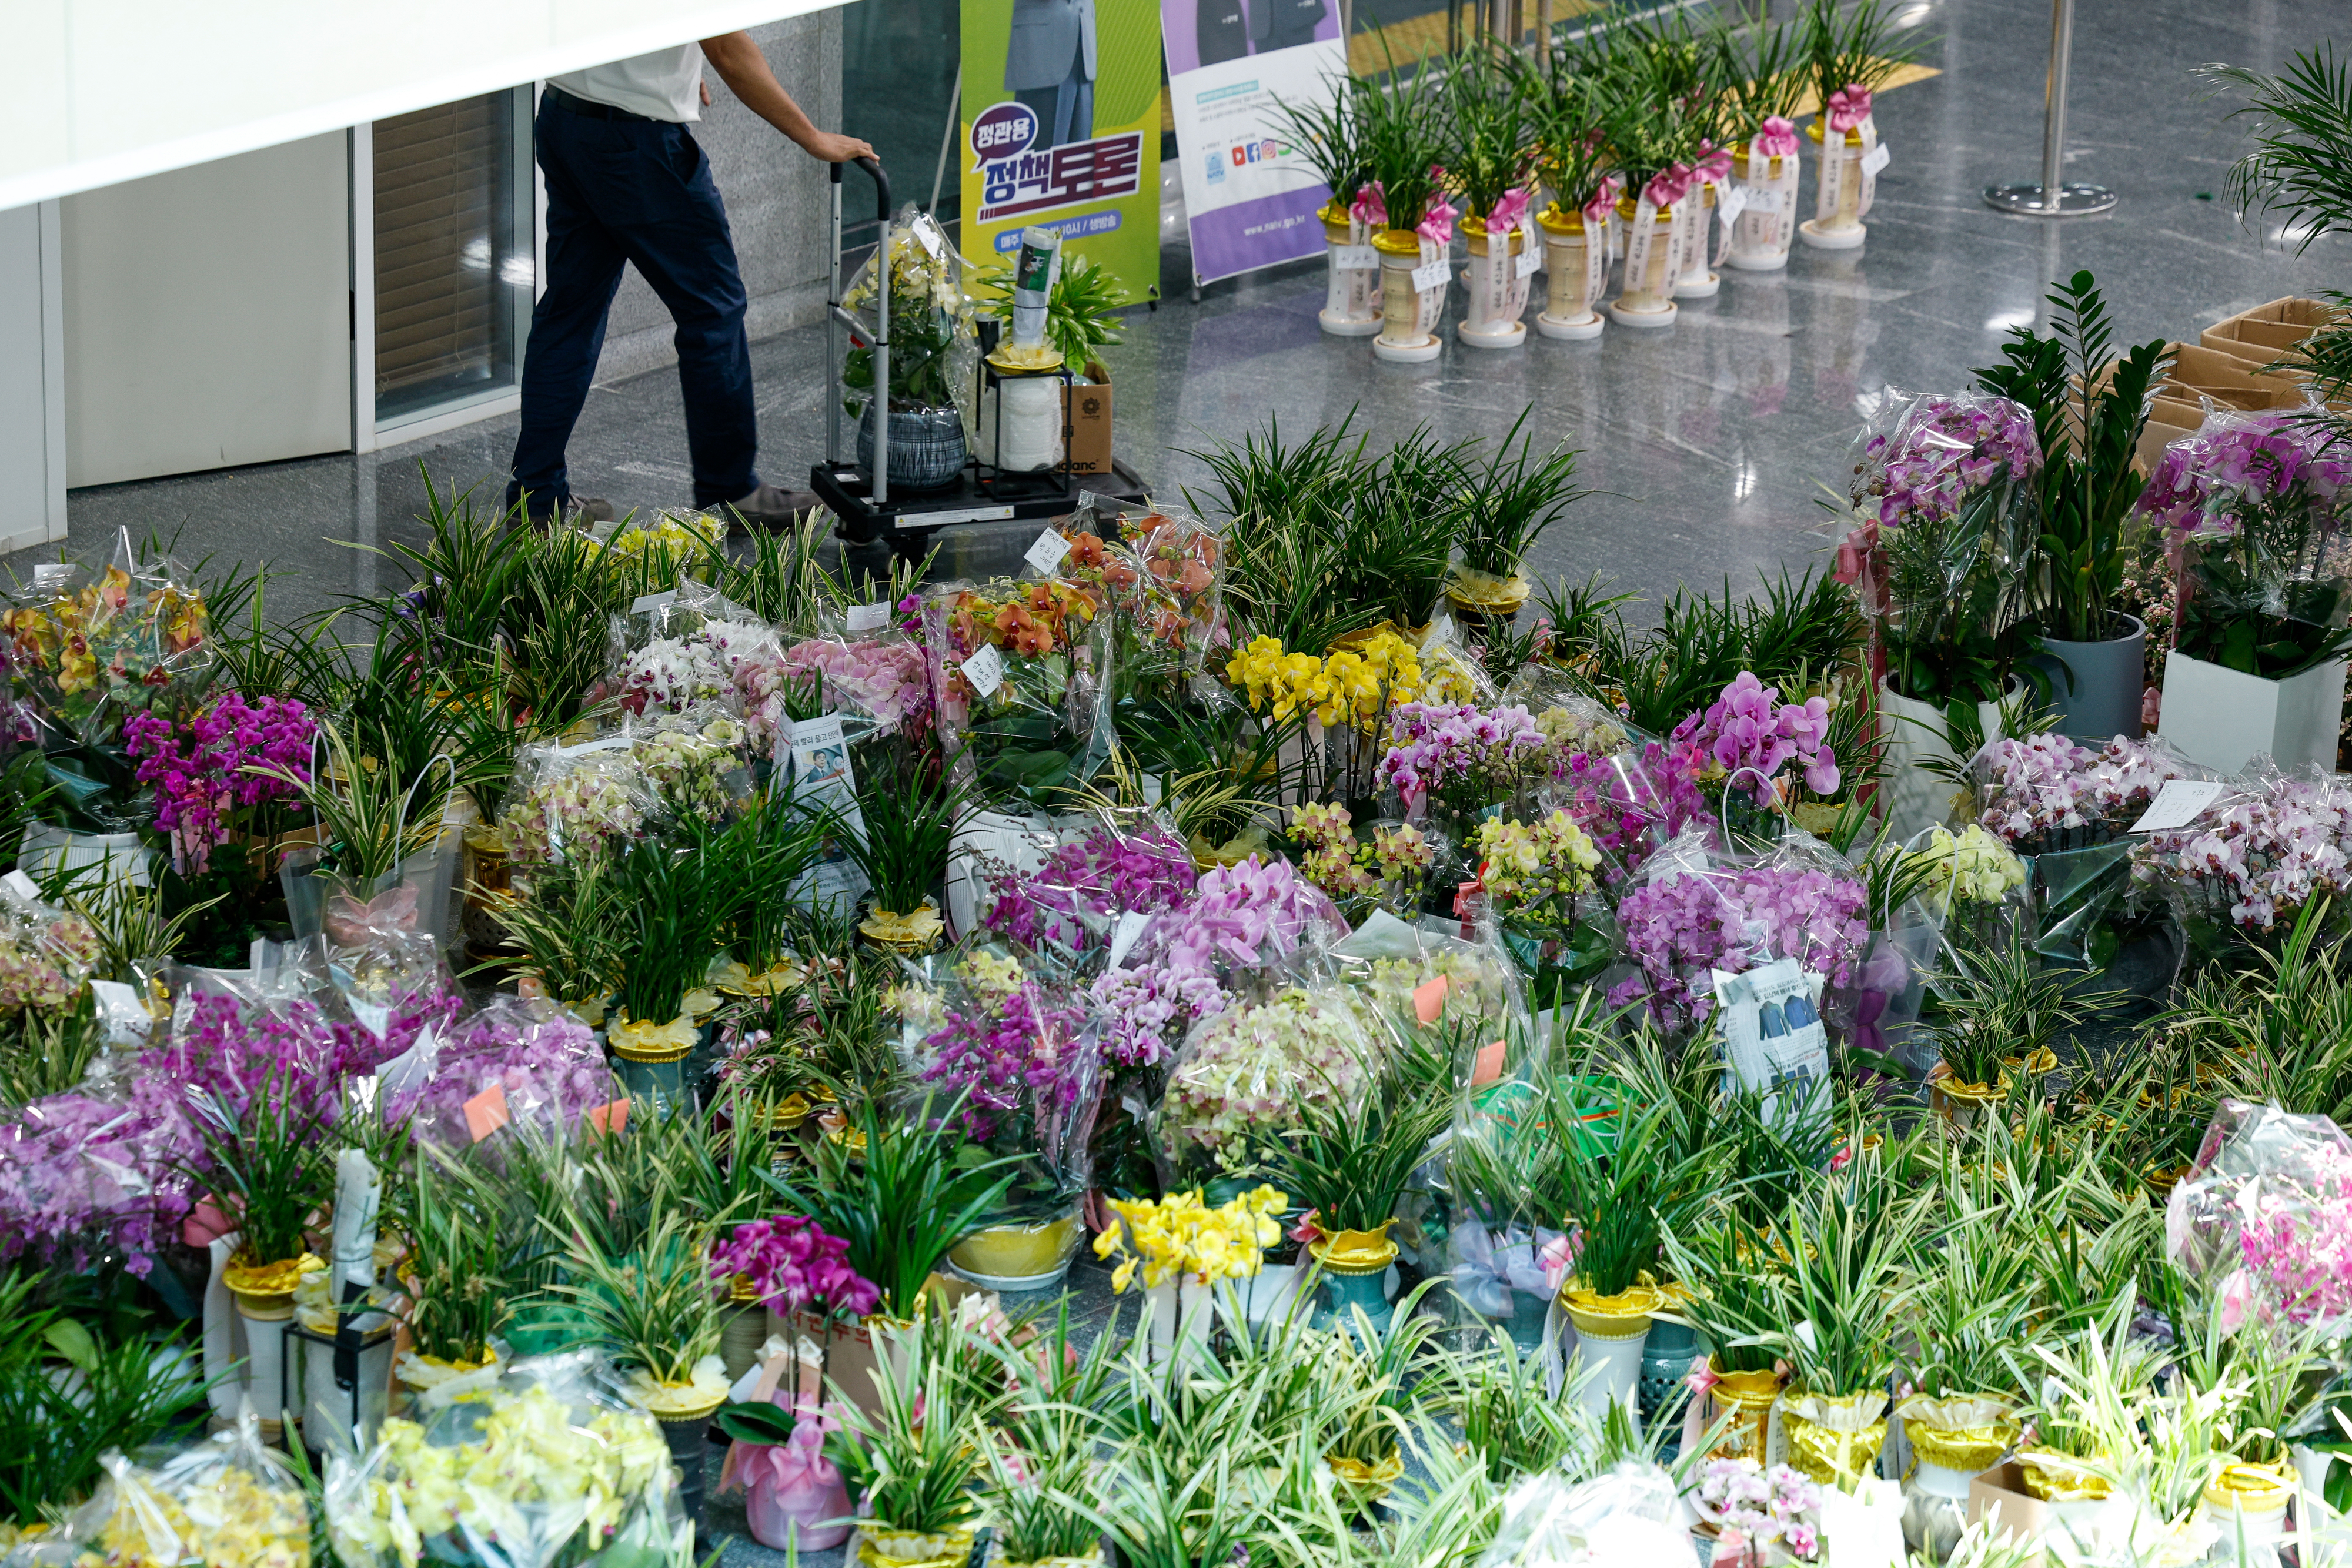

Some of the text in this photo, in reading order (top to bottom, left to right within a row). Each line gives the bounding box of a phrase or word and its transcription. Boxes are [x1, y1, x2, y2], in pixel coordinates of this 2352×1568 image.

[977, 117, 1030, 149] 정관용
[985, 135, 1140, 204] 정책토론
[1089, 215, 1117, 230] 생방송
[1040, 556, 1053, 567] 의원님
[800, 736, 813, 746] 빨리
[815, 734, 827, 743] 풀고
